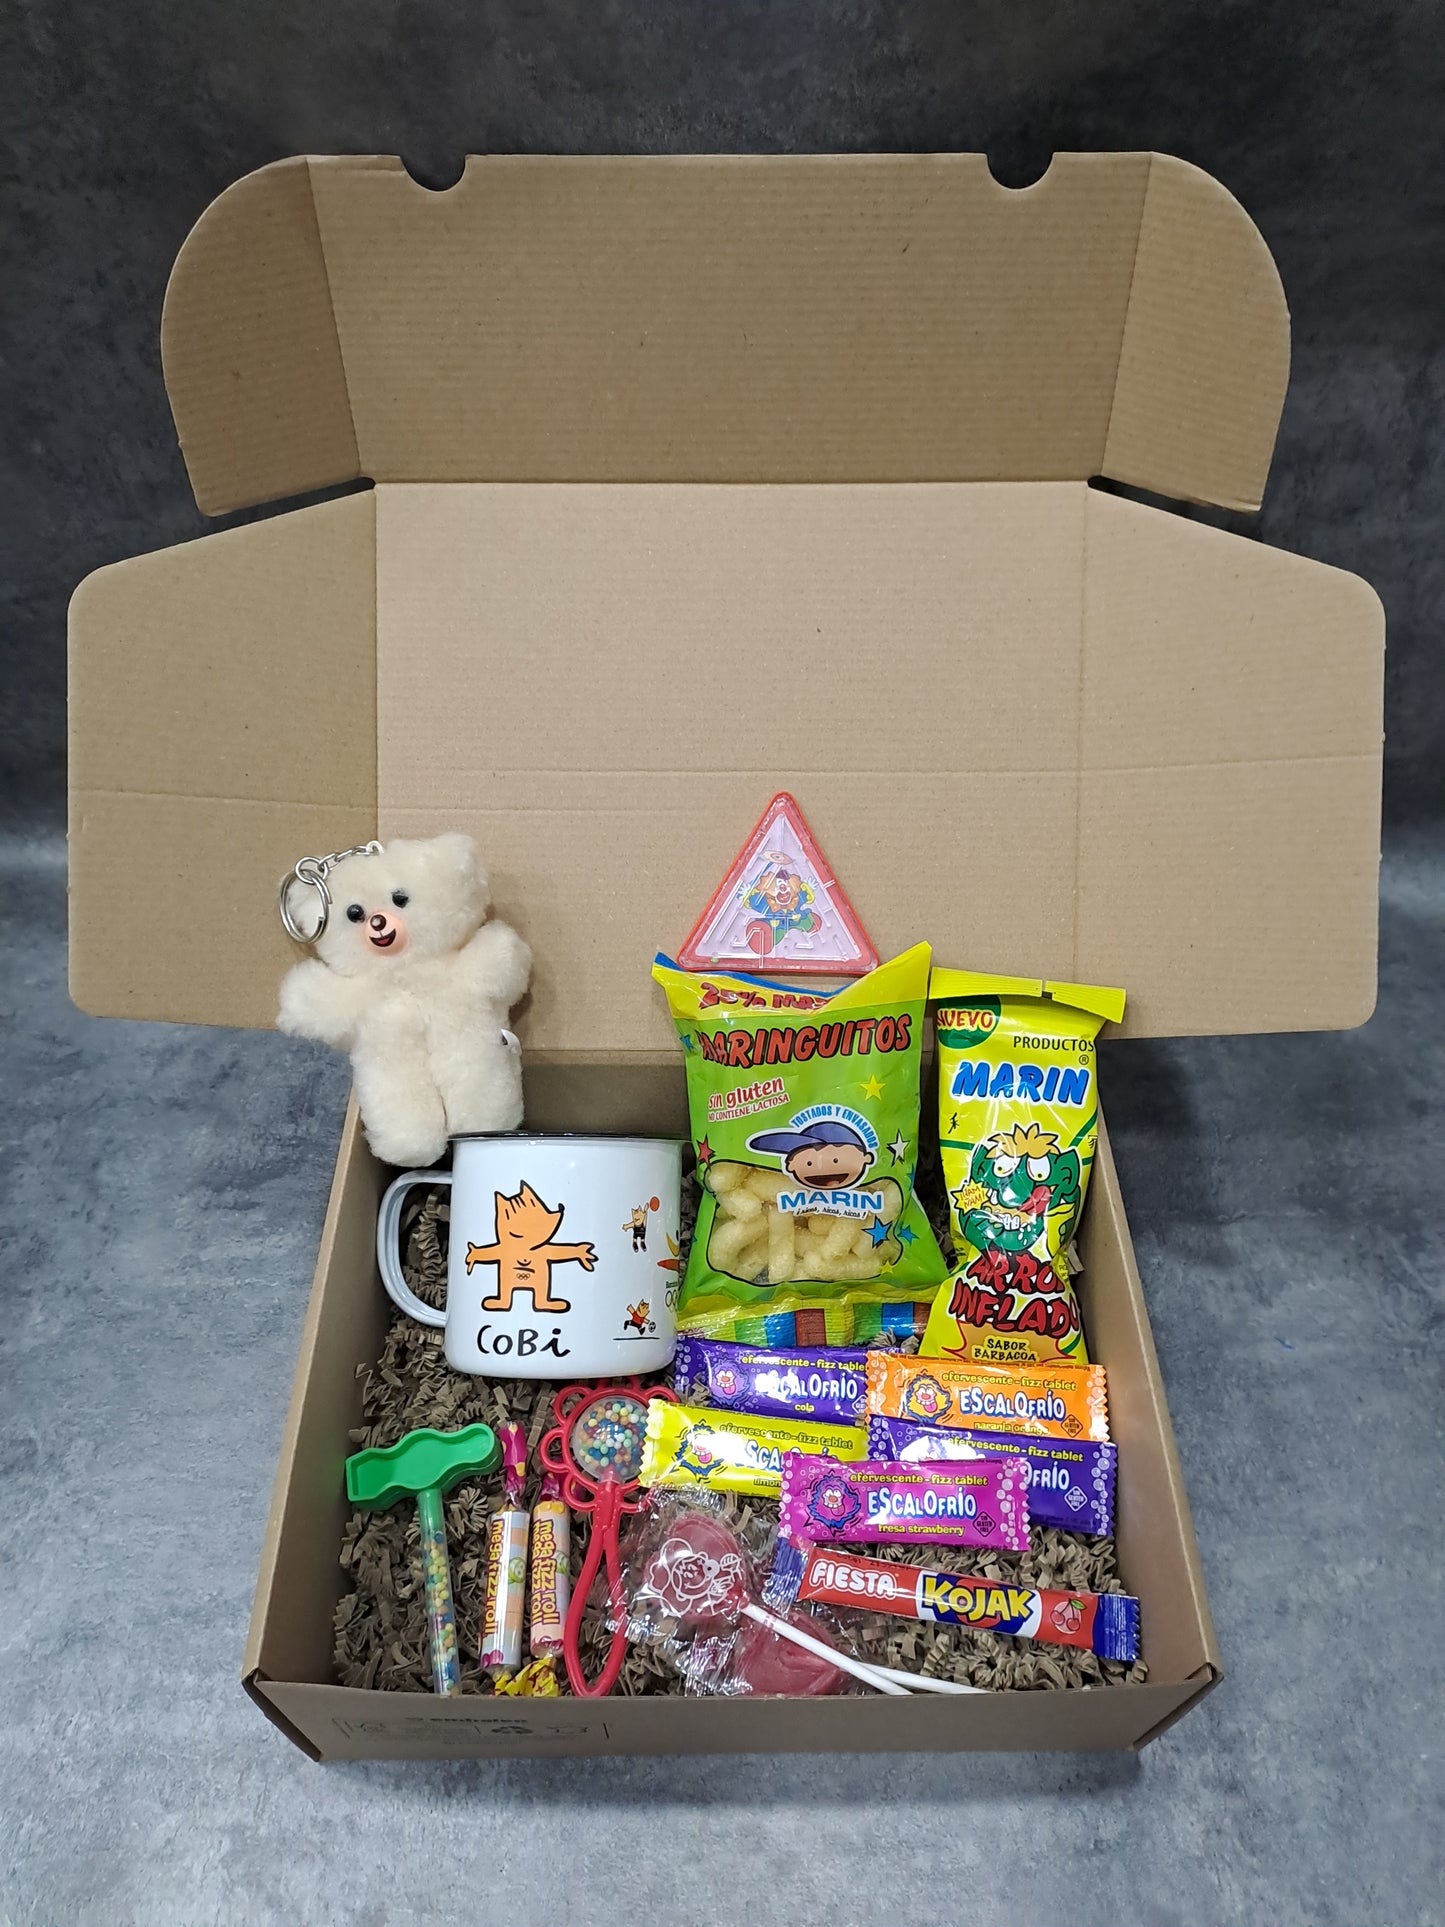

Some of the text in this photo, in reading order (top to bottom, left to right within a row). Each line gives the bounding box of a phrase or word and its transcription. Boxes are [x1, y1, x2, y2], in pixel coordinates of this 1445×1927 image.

[699, 982, 766, 1009] 25%
[937, 1010, 993, 1028] NUEVO
[696, 1014, 912, 1069] MARINGUITOS
[1013, 1035, 1095, 1053] PRODUCTOS
[709, 1077, 784, 1109] sin gluten
[951, 1061, 1090, 1106] MARIN
[716, 1105, 751, 1121] CONTIENE
[753, 1094, 790, 1112] LACTOSA
[790, 1105, 879, 1149] TOSTADOS Y ENVASADOS
[780, 1191, 882, 1210] MARIN
[949, 1279, 1080, 1338] INFLADO
[974, 1349, 1038, 1362] BARBACOA
[986, 1338, 1027, 1351] SABOR
[816, 1359, 836, 1370] fizz
[838, 1360, 867, 1372] table
[942, 1372, 1014, 1386] efervescente
[1021, 1376, 1042, 1388] fizz
[1044, 1378, 1077, 1391] tablet
[794, 1402, 814, 1412] cola
[719, 1423, 791, 1440] efervescente
[797, 1432, 818, 1445] fizz
[820, 1436, 853, 1450] tablet
[973, 1421, 1012, 1432] naranja
[948, 1436, 1020, 1454] efervescente
[1027, 1445, 1050, 1457] fizz
[1051, 1450, 1084, 1462] tablet
[850, 1473, 924, 1484] efervescente
[931, 1473, 952, 1485] fizz
[955, 1475, 988, 1486] tablet
[878, 1524, 965, 1536] fresa strawberry
[484, 1518, 505, 1635] mega fizz roll
[540, 1519, 560, 1625] mega fizz roll
[810, 1560, 897, 1600] FIESTA
[921, 1574, 1037, 1622] KOJAK
